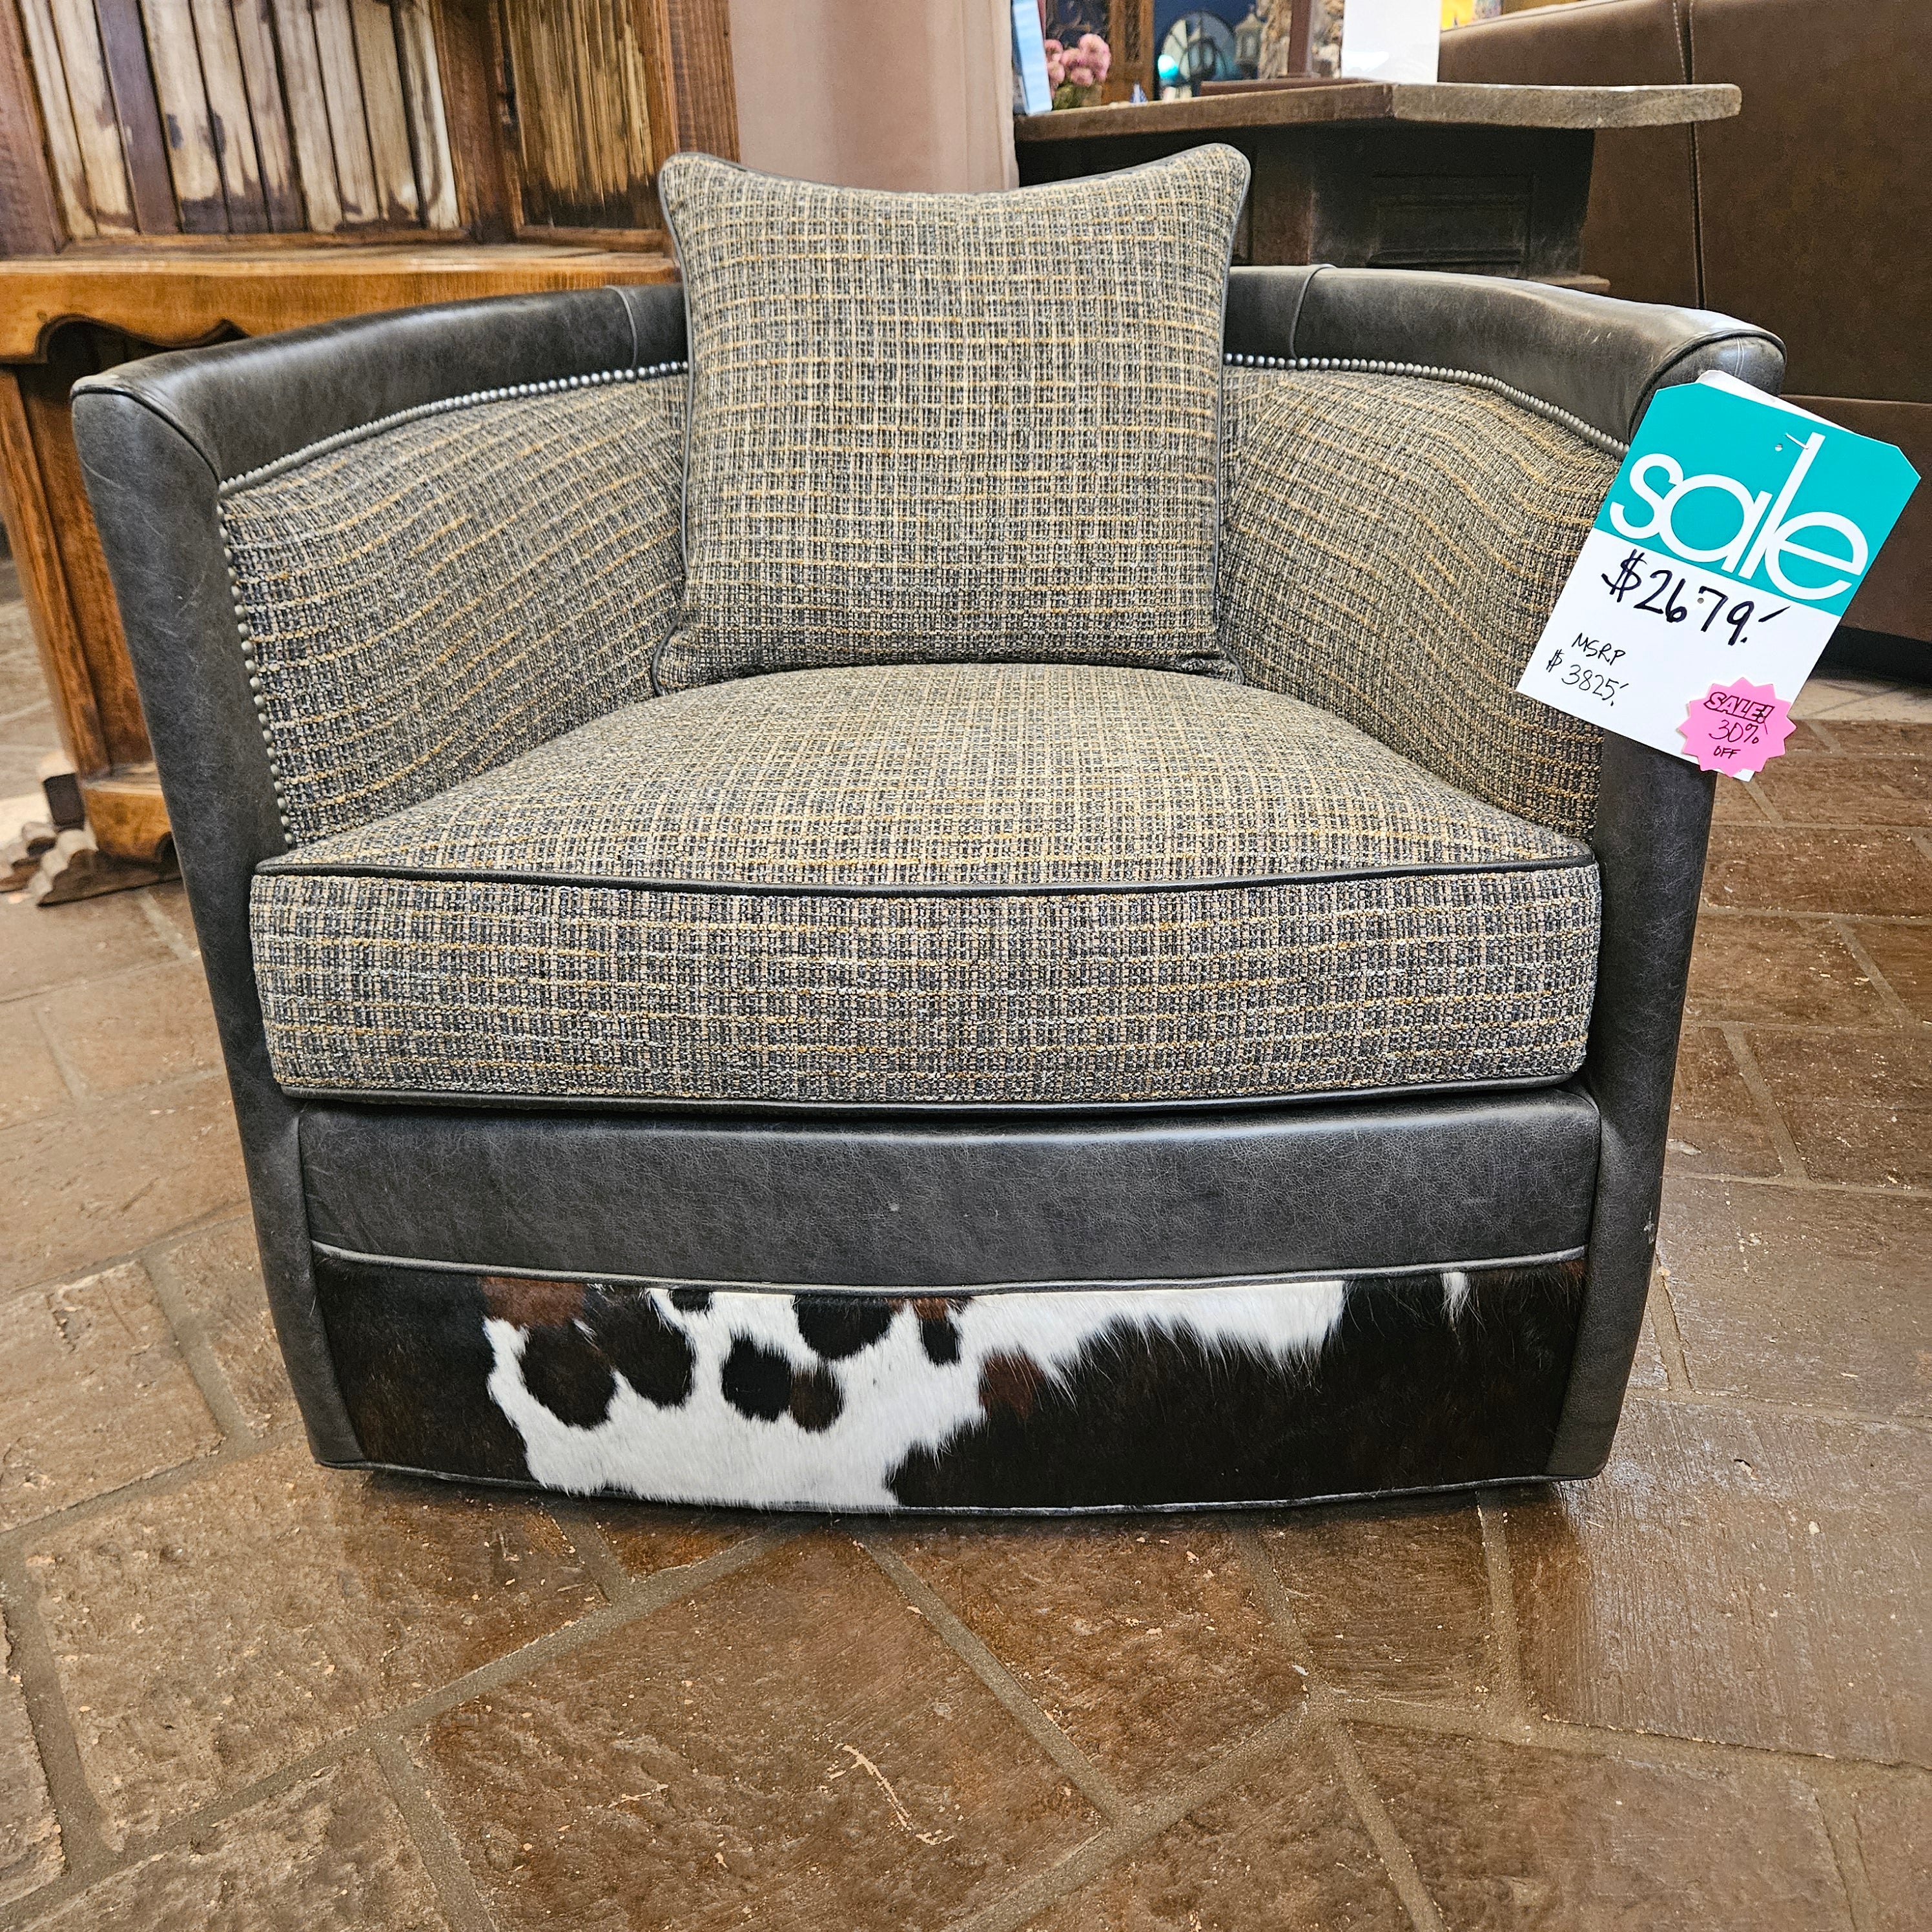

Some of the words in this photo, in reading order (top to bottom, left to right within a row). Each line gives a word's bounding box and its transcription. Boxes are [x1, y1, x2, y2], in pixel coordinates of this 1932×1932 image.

[1610, 433, 1869, 600] sale
[1571, 632, 1626, 666] MSRP
[1703, 692, 1776, 724] SALE!
[1708, 719, 1760, 744] 30%
[1713, 745, 1742, 759] OFF
